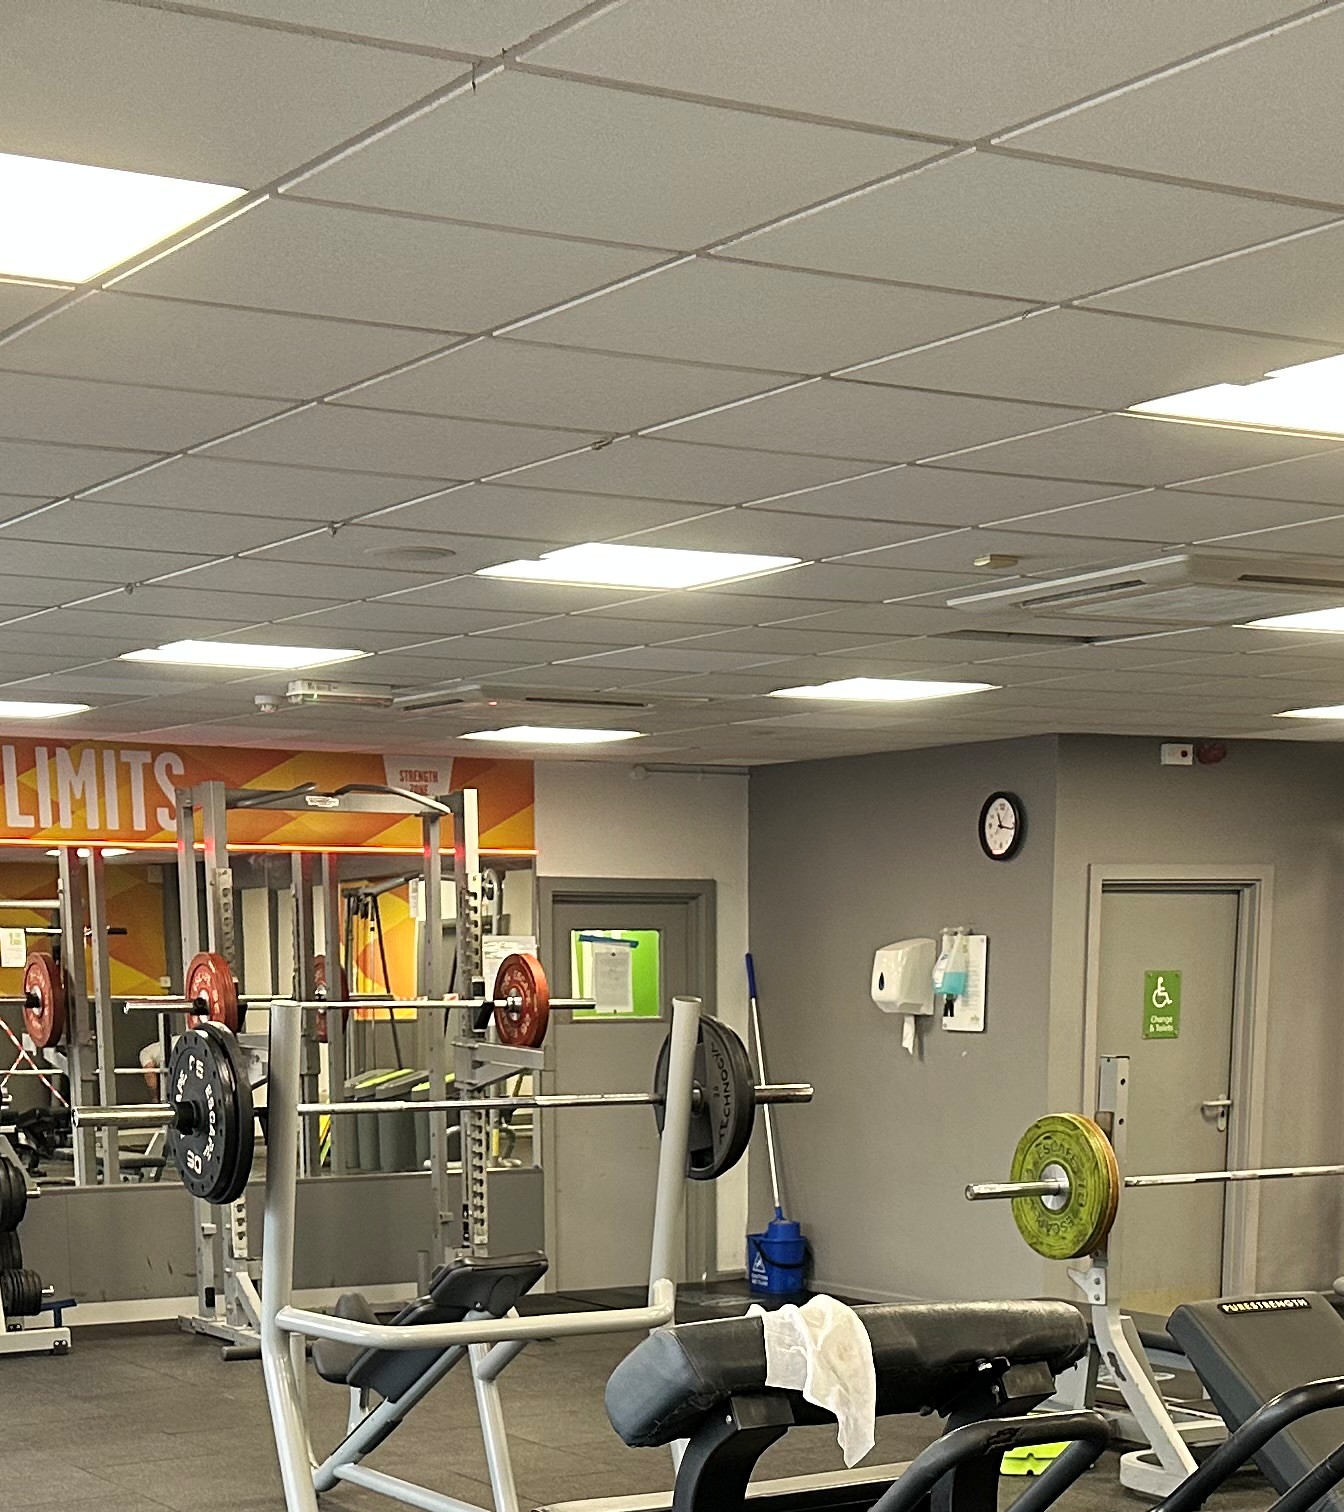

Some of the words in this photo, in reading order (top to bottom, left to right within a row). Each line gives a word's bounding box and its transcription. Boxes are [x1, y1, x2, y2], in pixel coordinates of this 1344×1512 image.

[1, 744, 185, 832] LIMITS
[399, 769, 439, 784] STRENGTH
[203, 1083, 216, 1162] ESCAPE
